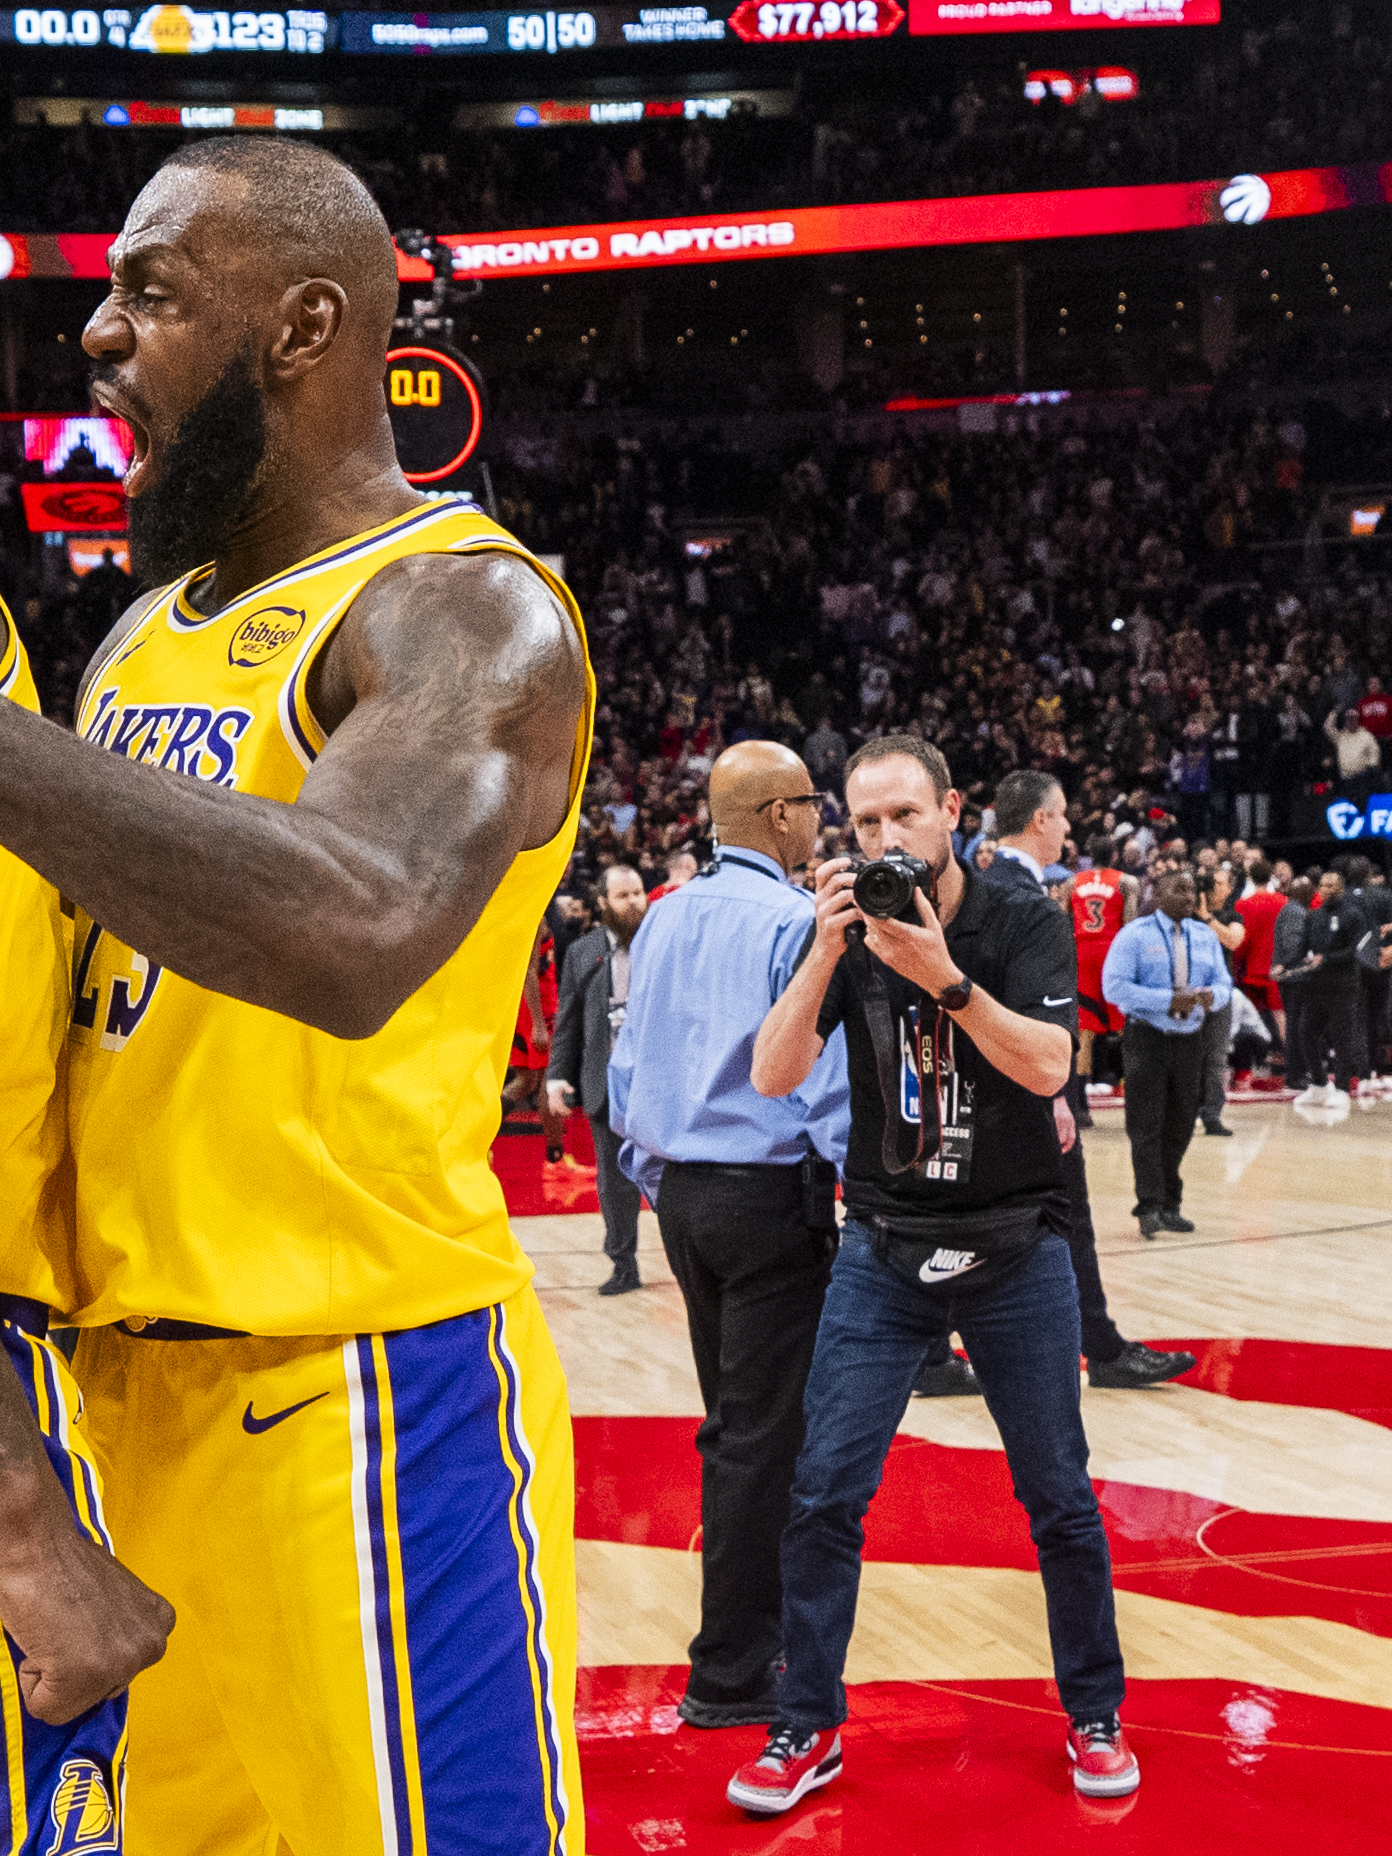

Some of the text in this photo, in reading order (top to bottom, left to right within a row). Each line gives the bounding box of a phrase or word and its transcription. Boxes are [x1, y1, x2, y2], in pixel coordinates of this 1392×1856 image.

[14, 9, 100, 45] 00.0
[212, 11, 286, 50] 123
[758, 1, 878, 39] $77,912
[451, 222, 795, 269] ORONTO RAPTORS
[391, 369, 440, 407] 0.0
[240, 621, 295, 650] bibigo
[1083, 899, 1105, 932] 3
[921, 1035, 933, 1075] EOS
[930, 1248, 975, 1272] NIKE
